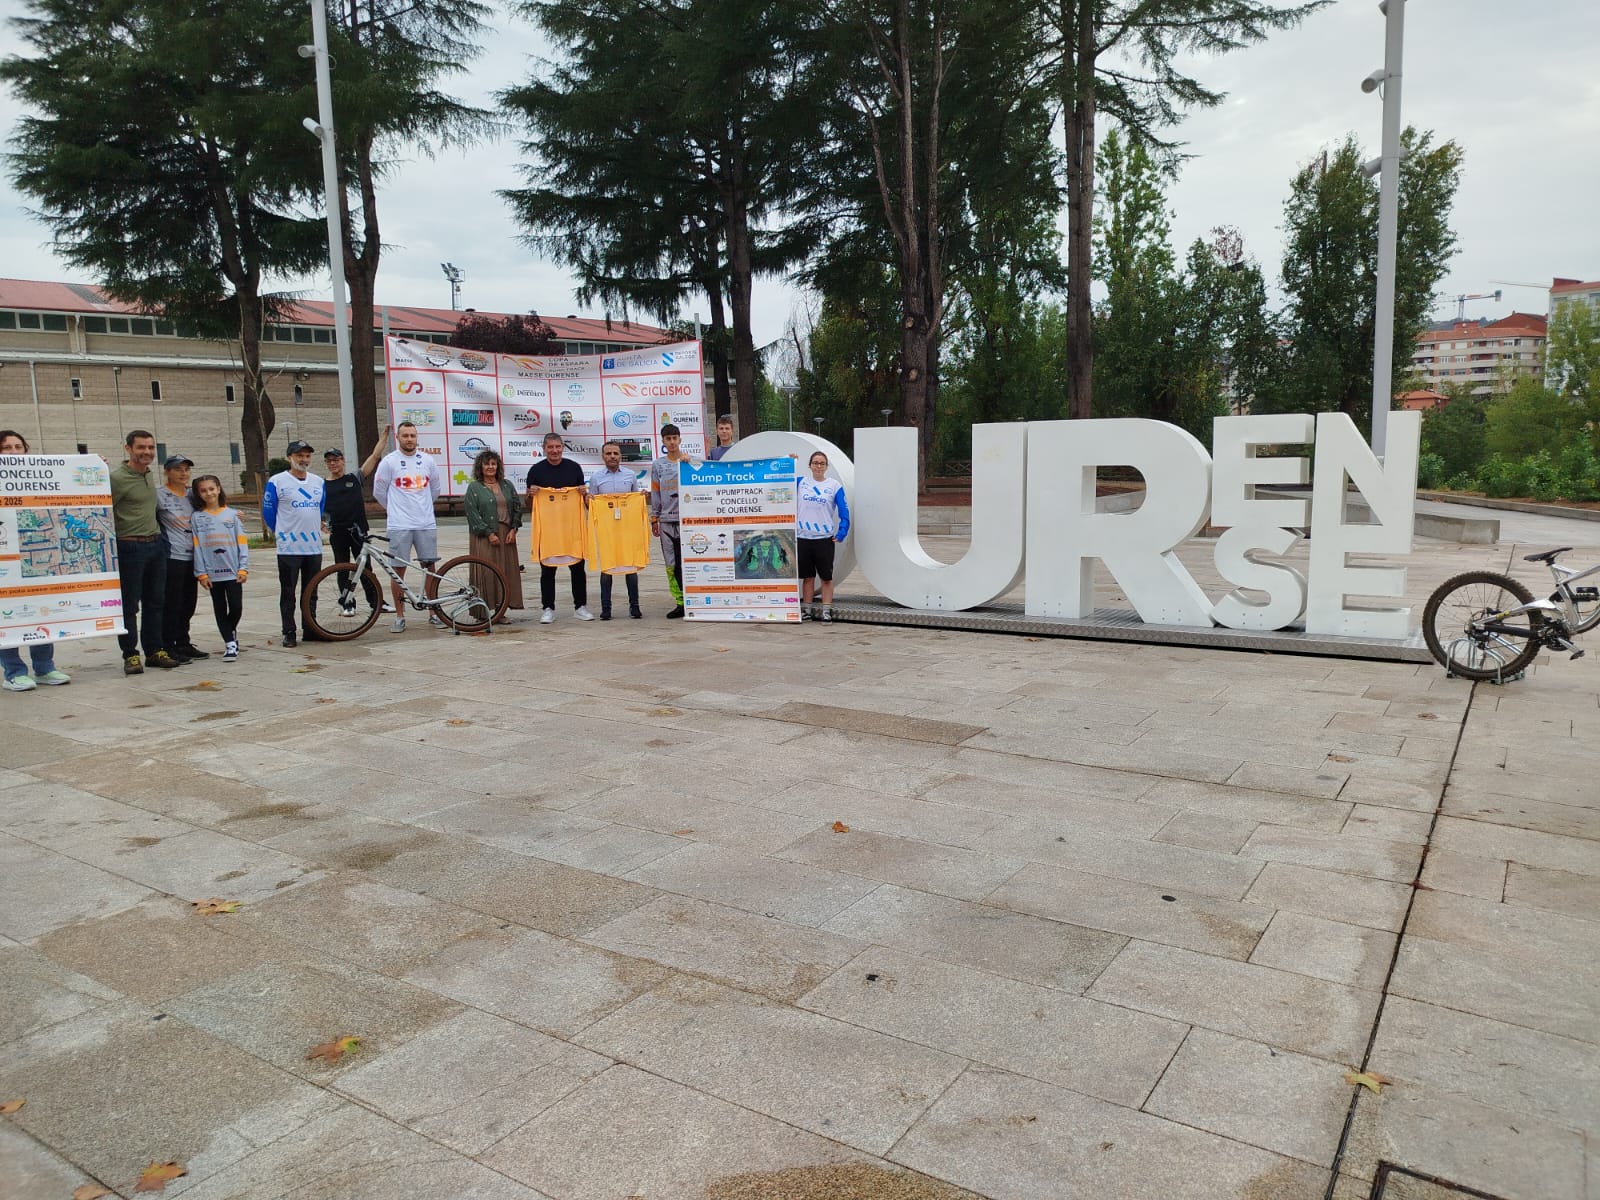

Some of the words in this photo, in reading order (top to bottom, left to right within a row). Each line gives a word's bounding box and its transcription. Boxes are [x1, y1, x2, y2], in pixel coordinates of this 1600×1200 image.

[640, 385, 691, 396] CICLISMO
[29, 457, 65, 466] Urbano
[0, 470, 53, 479] ONCELLO
[691, 474, 723, 483] Pump
[725, 472, 755, 481] Track
[5, 482, 61, 491] OURENSE
[721, 488, 764, 496] PUMPTRACK
[4, 497, 23, 506] 2025
[720, 497, 758, 505] CONCELLO
[802, 493, 827, 504] Galicia
[291, 500, 320, 508] Galicia
